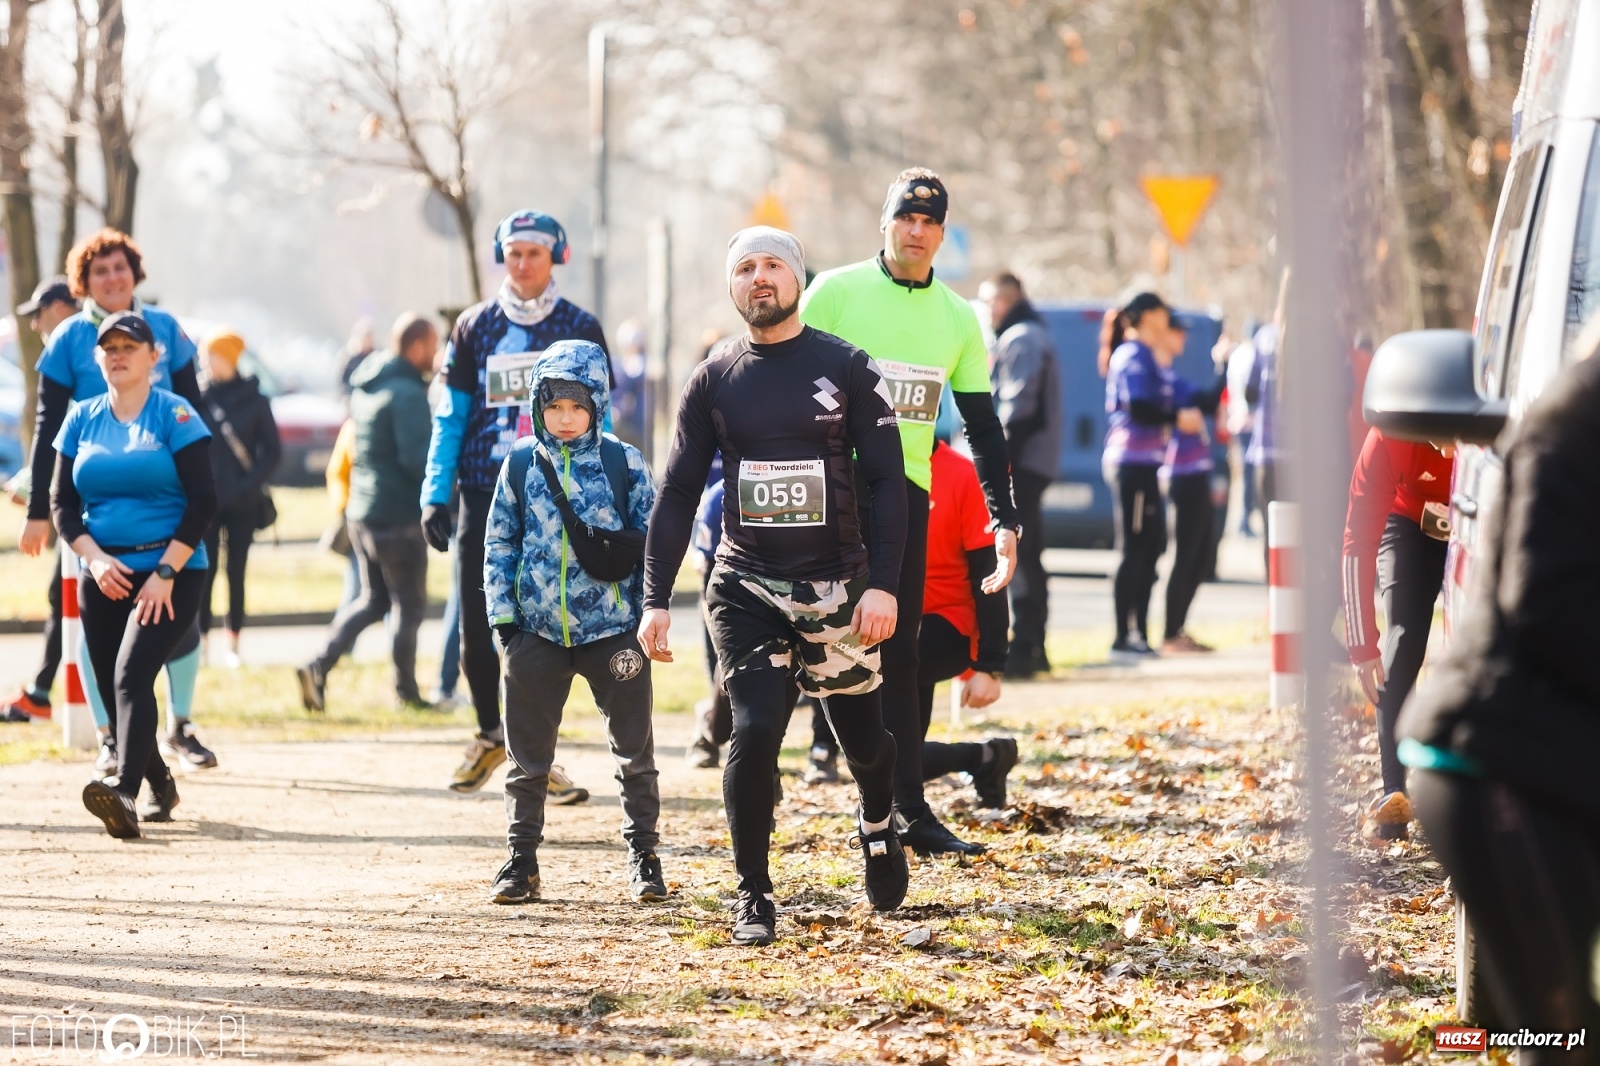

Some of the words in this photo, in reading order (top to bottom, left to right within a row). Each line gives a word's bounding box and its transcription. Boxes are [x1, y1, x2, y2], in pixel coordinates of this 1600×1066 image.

[894, 381, 927, 407] 118
[752, 463, 769, 471] BIEG
[769, 463, 814, 471] Twardziela
[753, 482, 808, 507] 059
